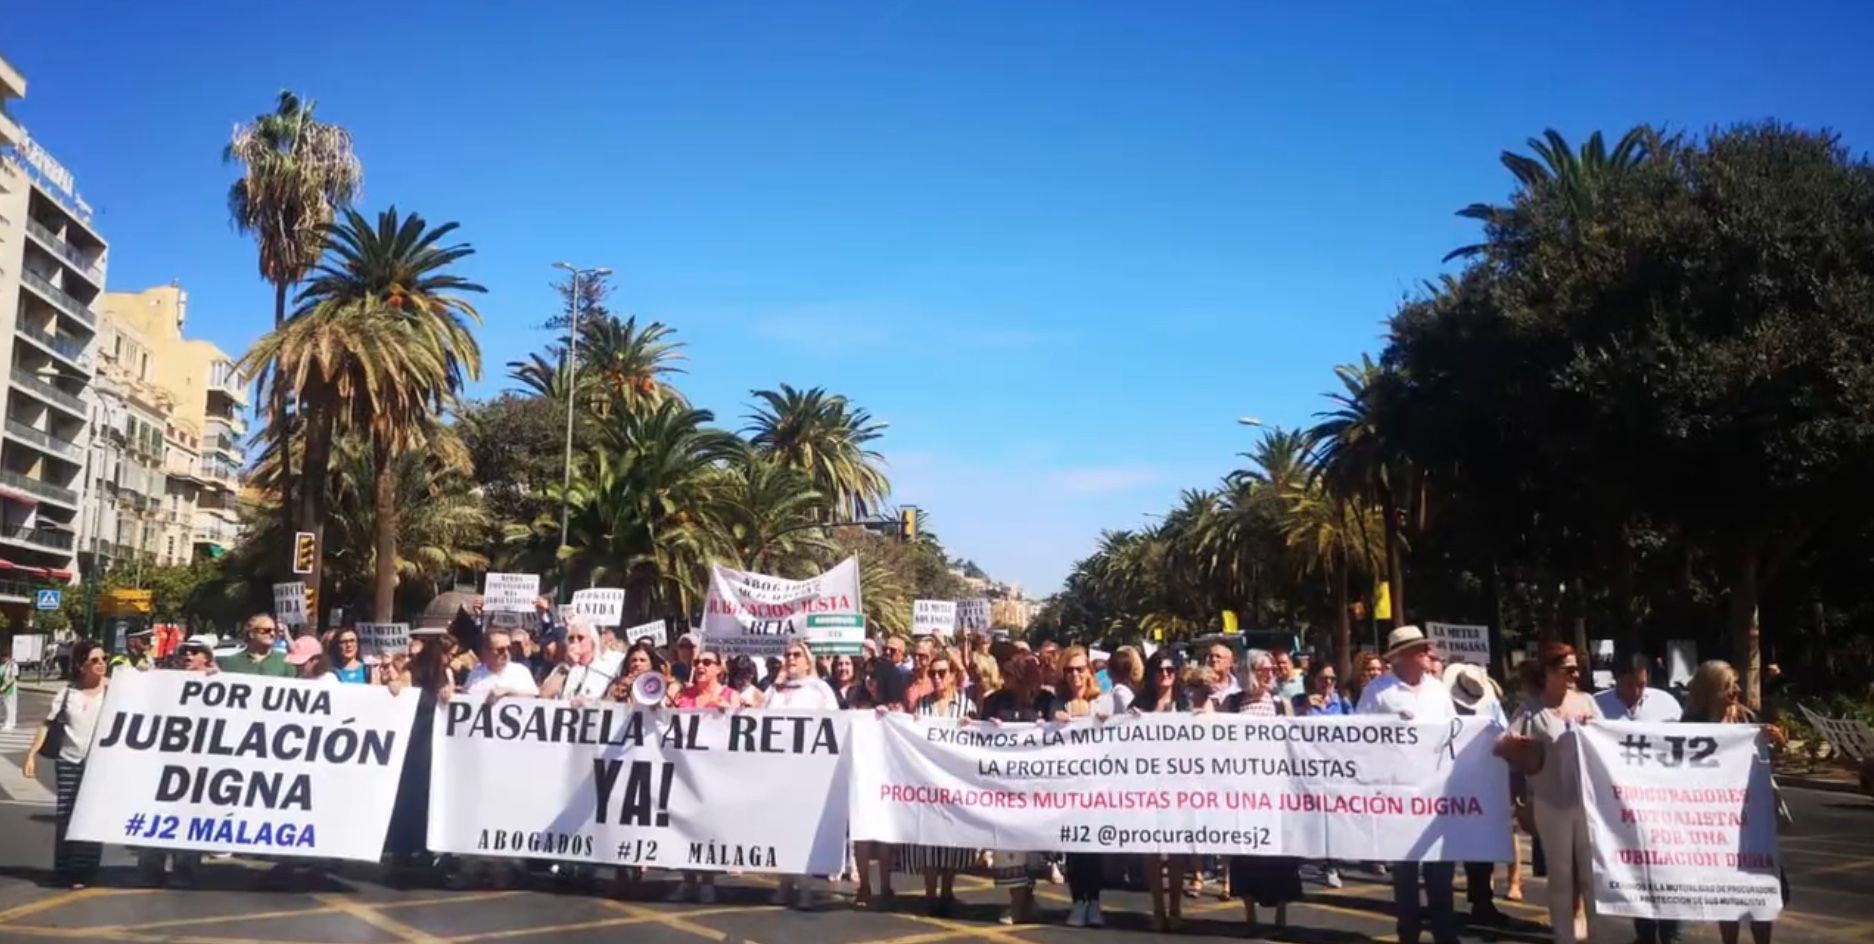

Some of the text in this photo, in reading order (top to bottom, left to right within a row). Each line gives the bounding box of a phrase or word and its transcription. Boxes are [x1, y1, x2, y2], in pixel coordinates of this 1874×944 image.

[576, 603, 615, 615] UNIDA
[749, 618, 796, 636] RETA
[1433, 625, 1444, 636] LA
[179, 681, 332, 716] POR UNA
[99, 711, 396, 766] JUBILACIÓN
[446, 704, 839, 755] PASARELA AL RETA
[927, 725, 1418, 747] EXIGIMOS A LA MUTUALIDAD DE PROCURADORES
[978, 754, 1356, 778] LA PROTECCIÓN DE SUS MUTUALISTAS
[1618, 734, 1720, 768] #J2
[155, 765, 313, 811] DIGNA
[593, 757, 675, 828] YA!
[881, 784, 1483, 816] PROCURADORES MUTUALISTAS POR UNA JUBILACIÓN DIGNA
[1612, 785, 1749, 804] PROCURADORES
[125, 813, 316, 849] #J2 MÁLAGA
[1060, 825, 1271, 849] #J2 @procuradoresj2
[1651, 829, 1728, 846] POR UNA
[477, 828, 777, 868] ABOGADOS #J2 MÁLAGA
